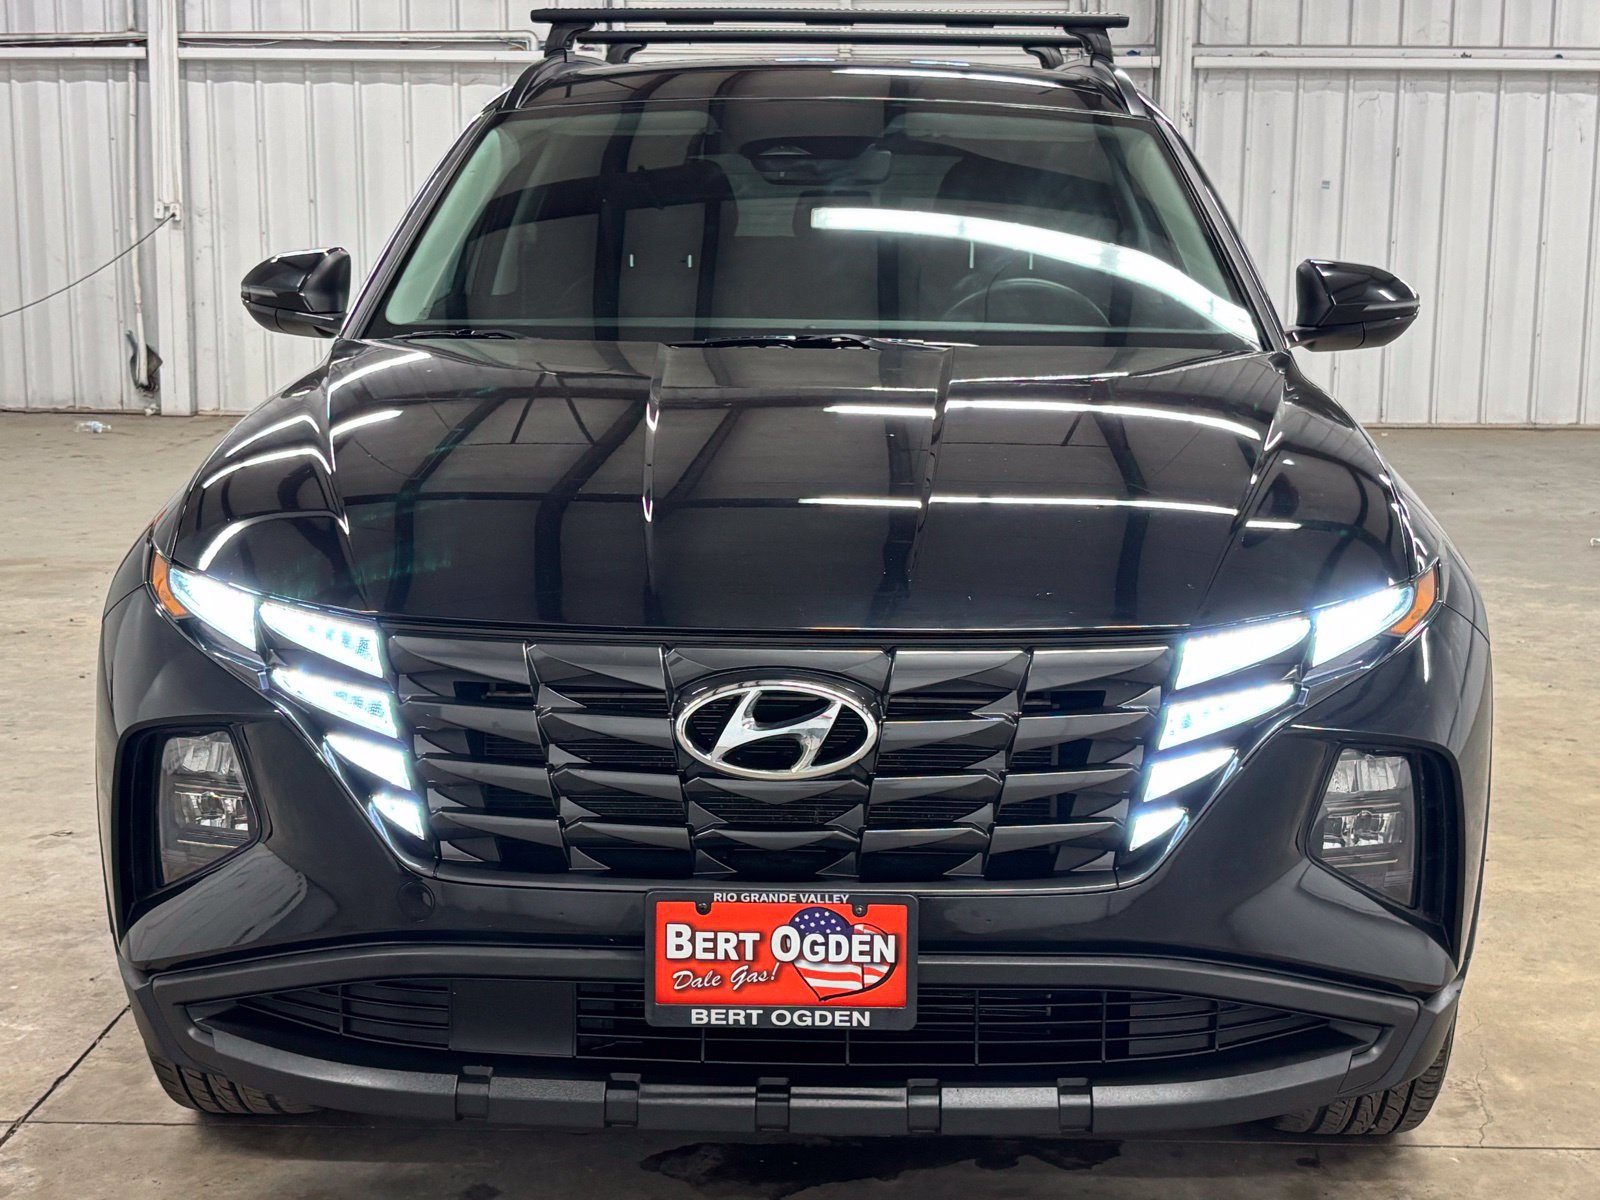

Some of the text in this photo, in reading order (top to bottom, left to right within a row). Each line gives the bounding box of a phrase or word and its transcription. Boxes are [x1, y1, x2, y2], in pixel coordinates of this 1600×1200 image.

[713, 892, 850, 904] RIO GRANDE VALLEY
[665, 922, 896, 963] BERT OGDEN
[672, 962, 780, 991] Dale Gas!
[690, 1008, 871, 1027] BERT OGDEN
